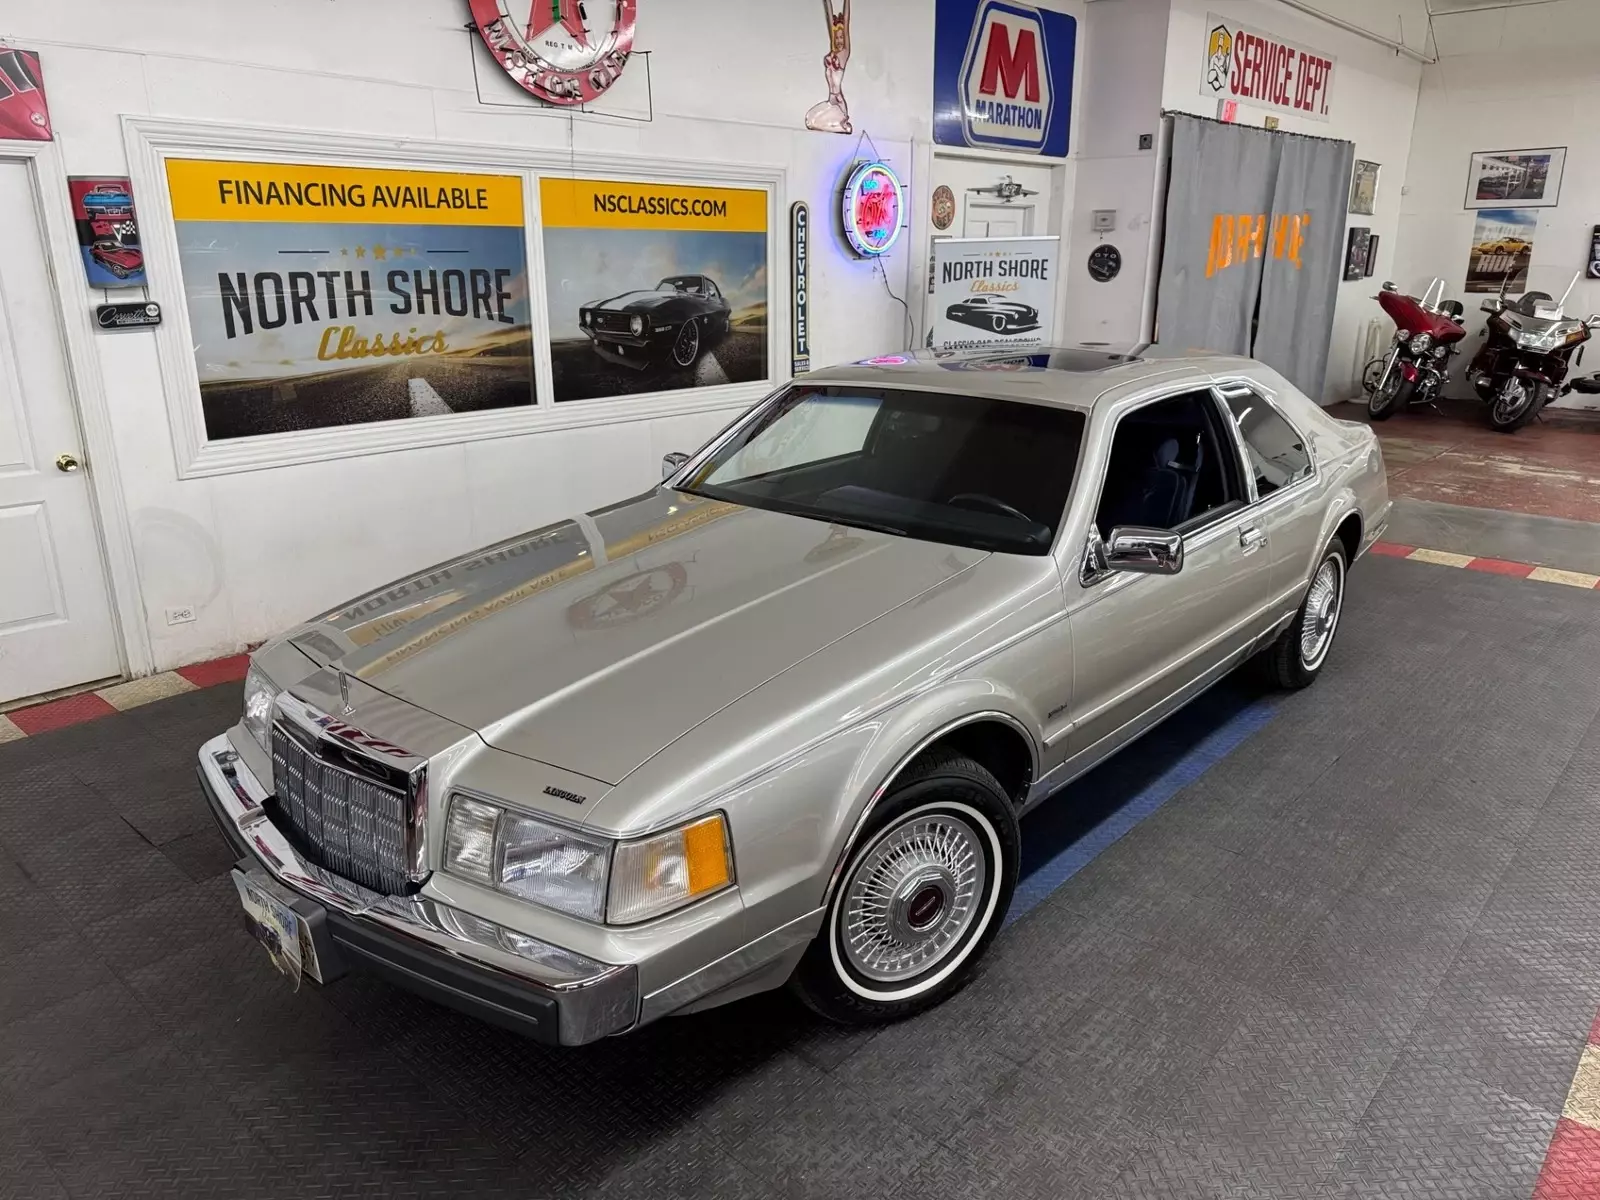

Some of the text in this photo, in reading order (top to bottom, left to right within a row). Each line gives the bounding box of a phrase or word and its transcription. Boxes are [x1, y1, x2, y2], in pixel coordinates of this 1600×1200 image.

[979, 21, 1040, 103] M
[1230, 30, 1333, 115] SERVICE DEPT.
[975, 99, 1042, 130] MARATHON
[218, 179, 489, 210] FINANCING AVAILABLE
[593, 193, 727, 218] NSCLASSICS.COM
[797, 210, 806, 352] CHEVROLET
[942, 260, 993, 284] NORTH
[998, 258, 1049, 281] SHORE
[970, 280, 1020, 293] Classics
[99, 307, 146, 325] Corvette
[218, 268, 514, 339] NORTH SHORE
[316, 325, 450, 361] Classics
[543, 786, 587, 805] LINCOLN
